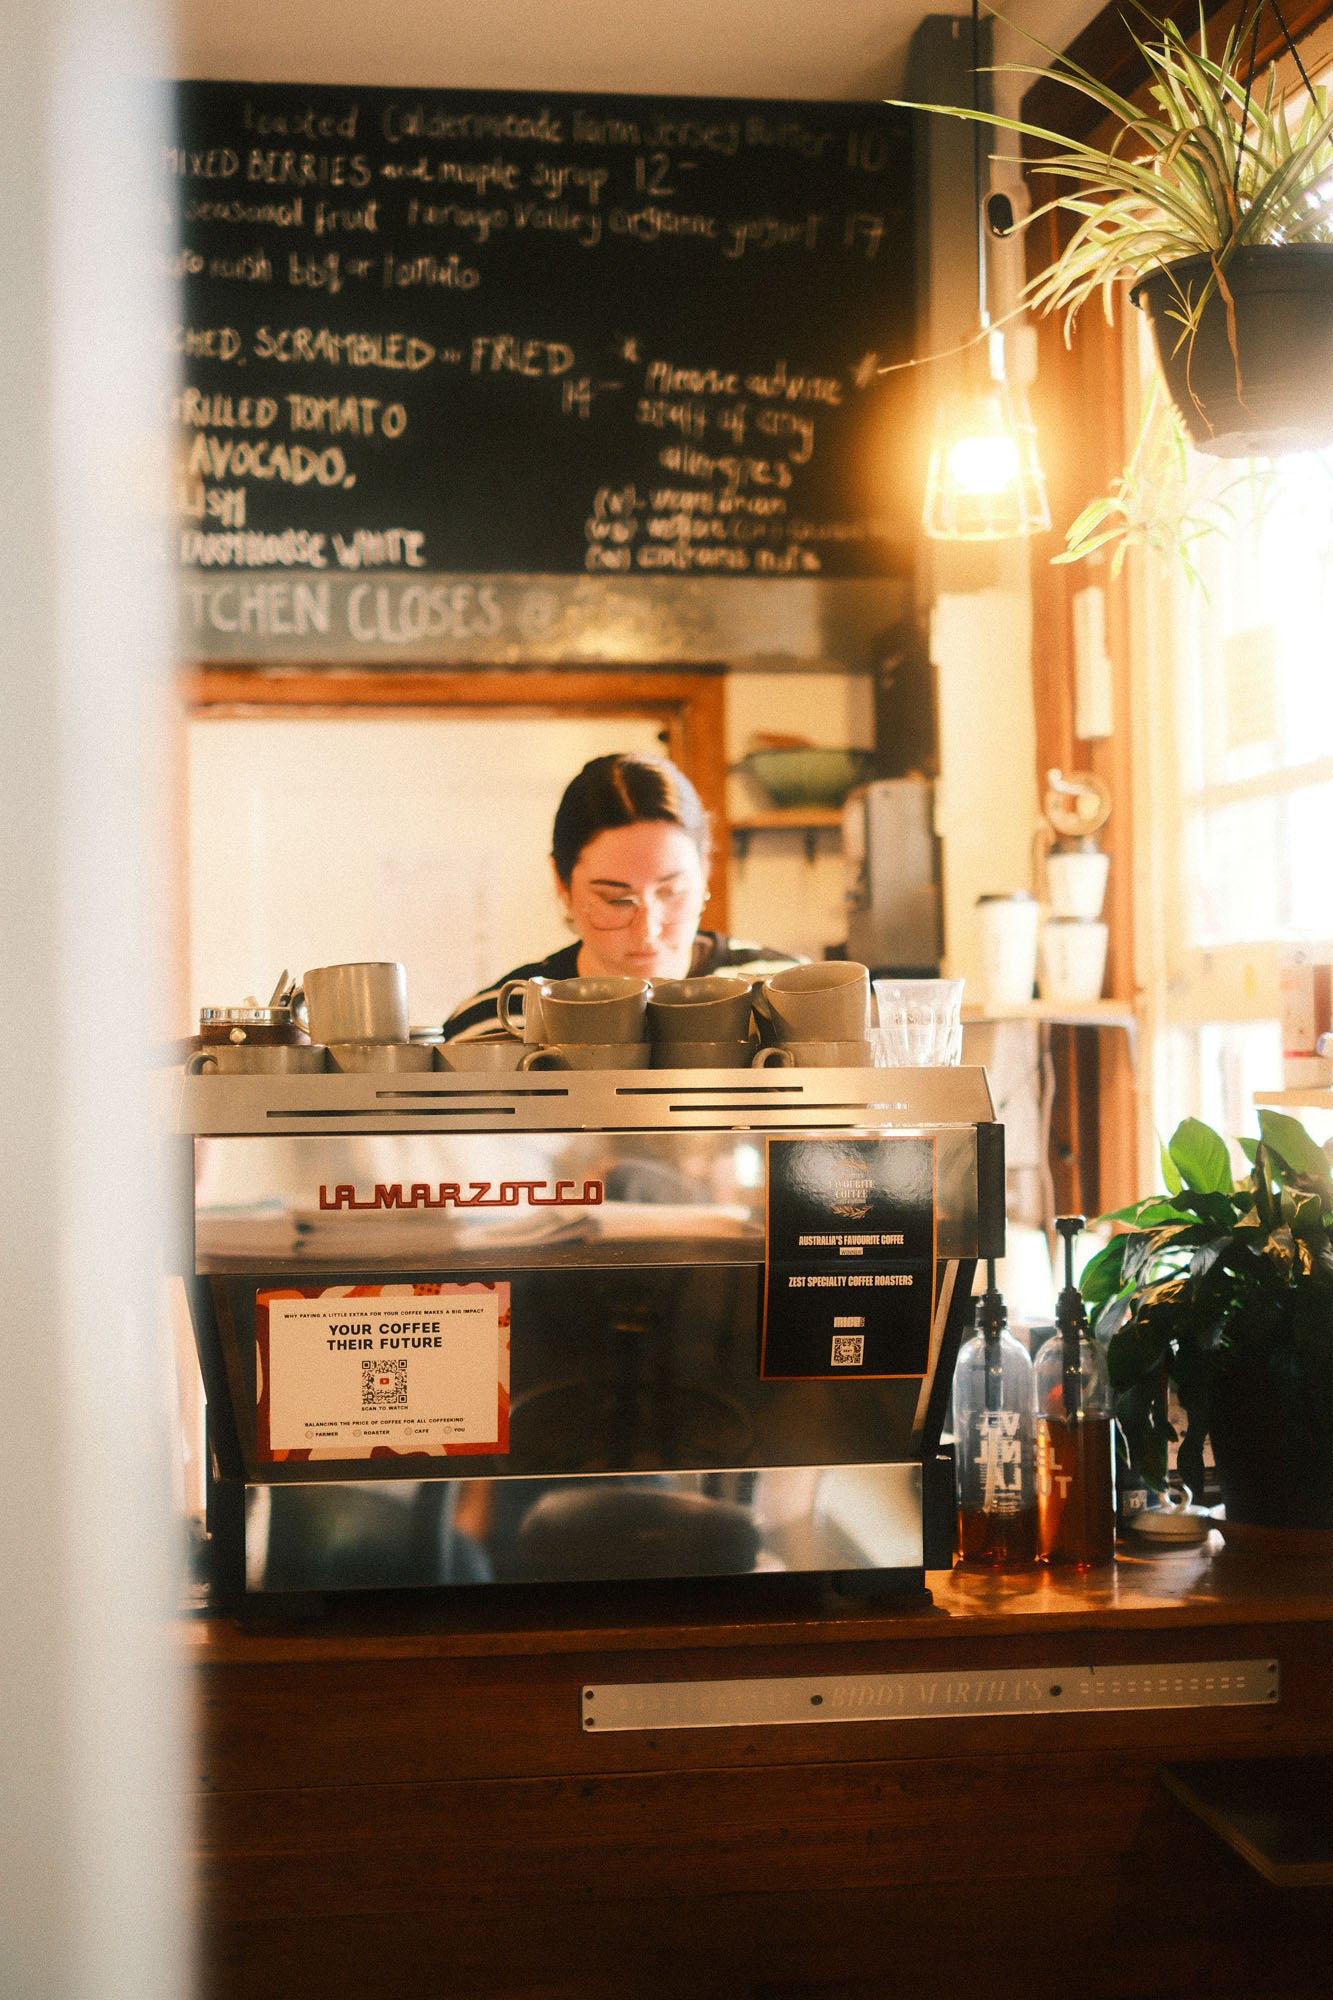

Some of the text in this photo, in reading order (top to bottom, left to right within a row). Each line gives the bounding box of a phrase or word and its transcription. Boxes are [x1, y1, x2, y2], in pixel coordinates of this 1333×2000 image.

[248, 149, 373, 188] BERRIES
[438, 160, 521, 196] maple
[531, 160, 609, 204] syrup
[313, 200, 379, 236] fruit
[253, 327, 437, 371] SCRAMBLED
[471, 334, 575, 378] FRIED
[332, 526, 428, 569] WHITE
[346, 581, 503, 643] CLOSES
[799, 1234, 904, 1246] AUSTRALIA'S FAVOURITE COFFEE
[788, 1275, 913, 1287] ZEST SPECIALTY COFFEE ROASTERS
[326, 1337, 442, 1351] THEIR FUTURE
[329, 1322, 440, 1336] YOUR COFFEE
